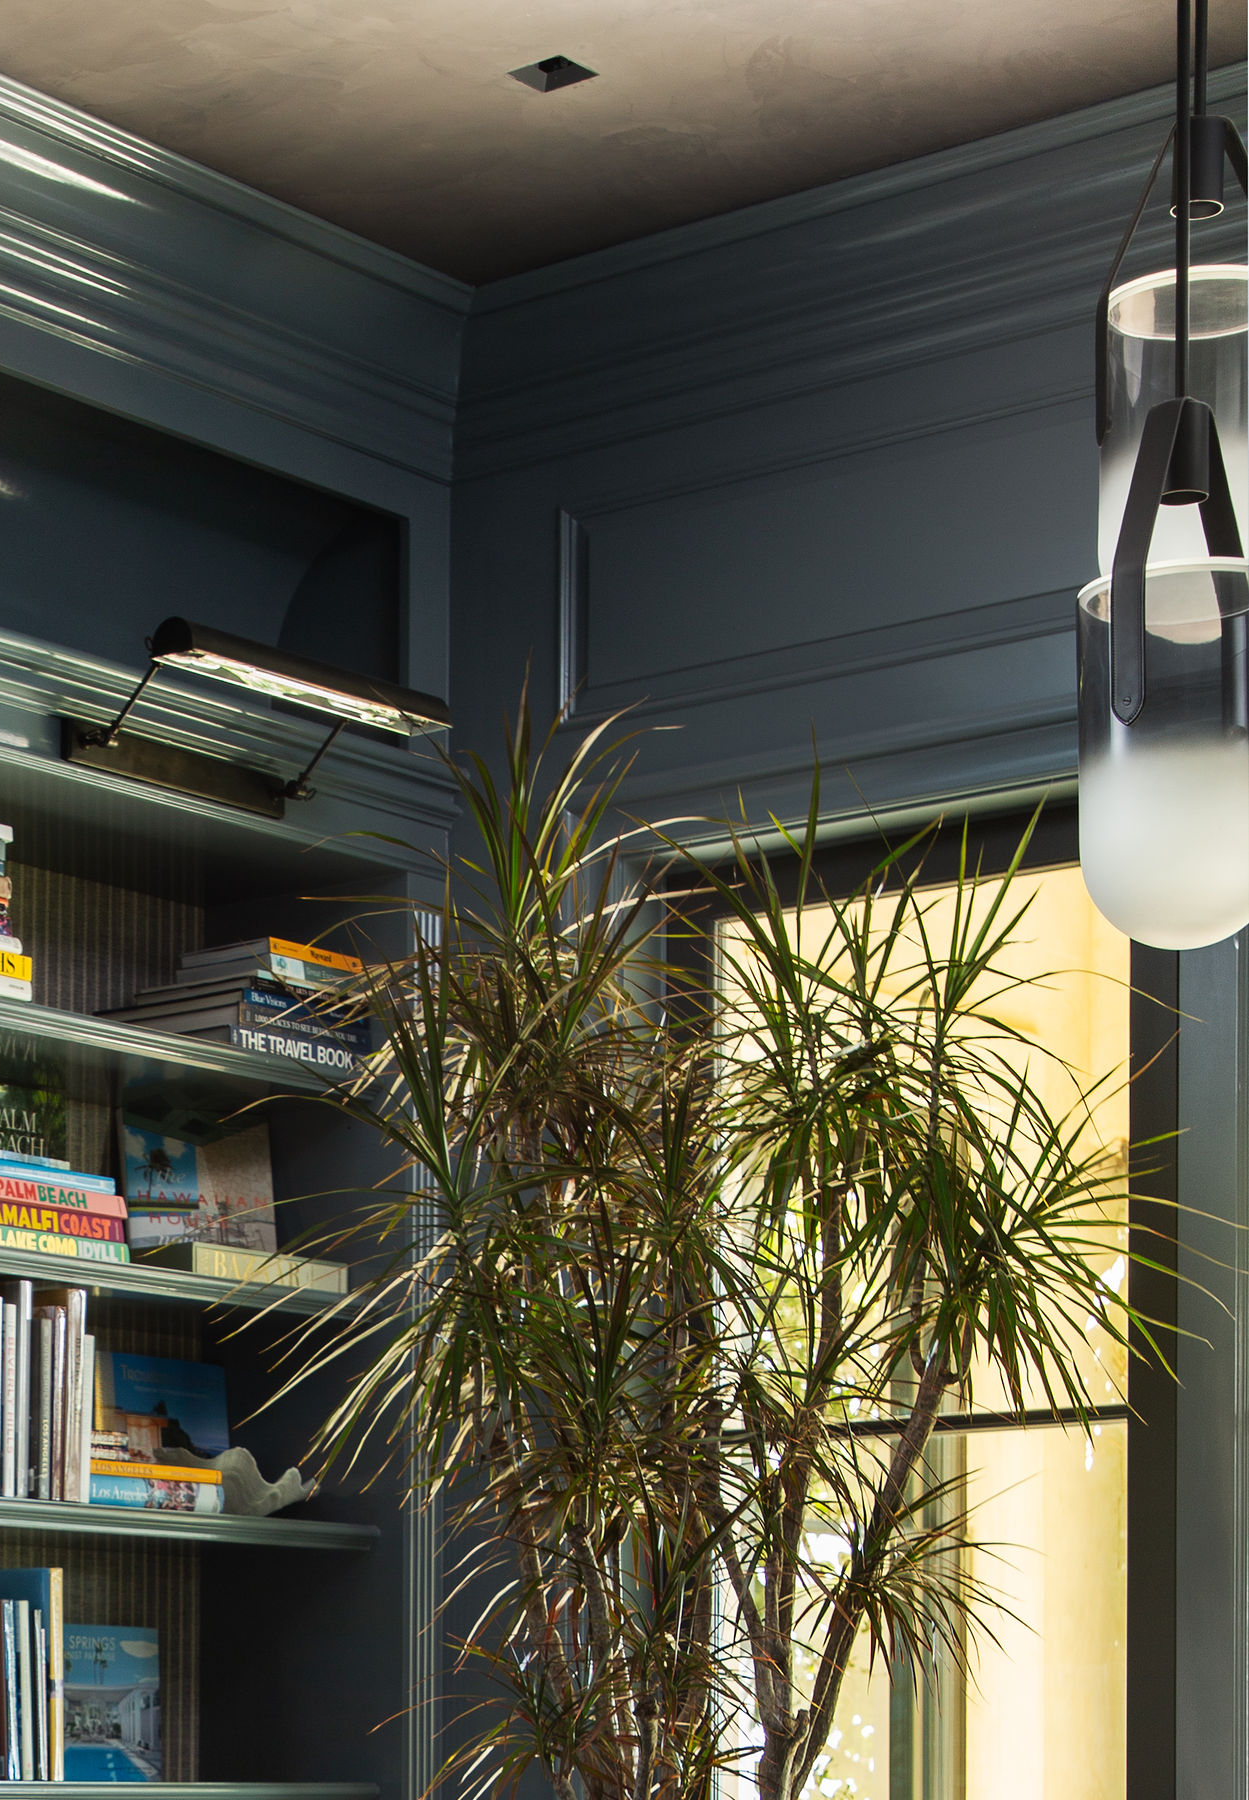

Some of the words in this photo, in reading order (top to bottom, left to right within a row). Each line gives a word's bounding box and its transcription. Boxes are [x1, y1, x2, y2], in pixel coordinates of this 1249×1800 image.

[239, 1027, 267, 1053] THE
[267, 1034, 317, 1063] TRAVEL
[317, 1044, 354, 1070] BOOK
[155, 1167, 186, 1184] the
[37, 1184, 88, 1209] BEACH
[137, 1189, 270, 1210] HAWAIIAN
[59, 1213, 112, 1240] COAST
[148, 1211, 230, 1229] HOUSE
[39, 1234, 77, 1257] COMO
[77, 1242, 118, 1263] IDYLL
[6, 1336, 15, 1406] BEVERLY
[6, 1411, 15, 1454] HILLS
[41, 1437, 49, 1479] ANGELES
[92, 1483, 111, 1498] Los
[69, 1635, 116, 1651] SPRINGS
